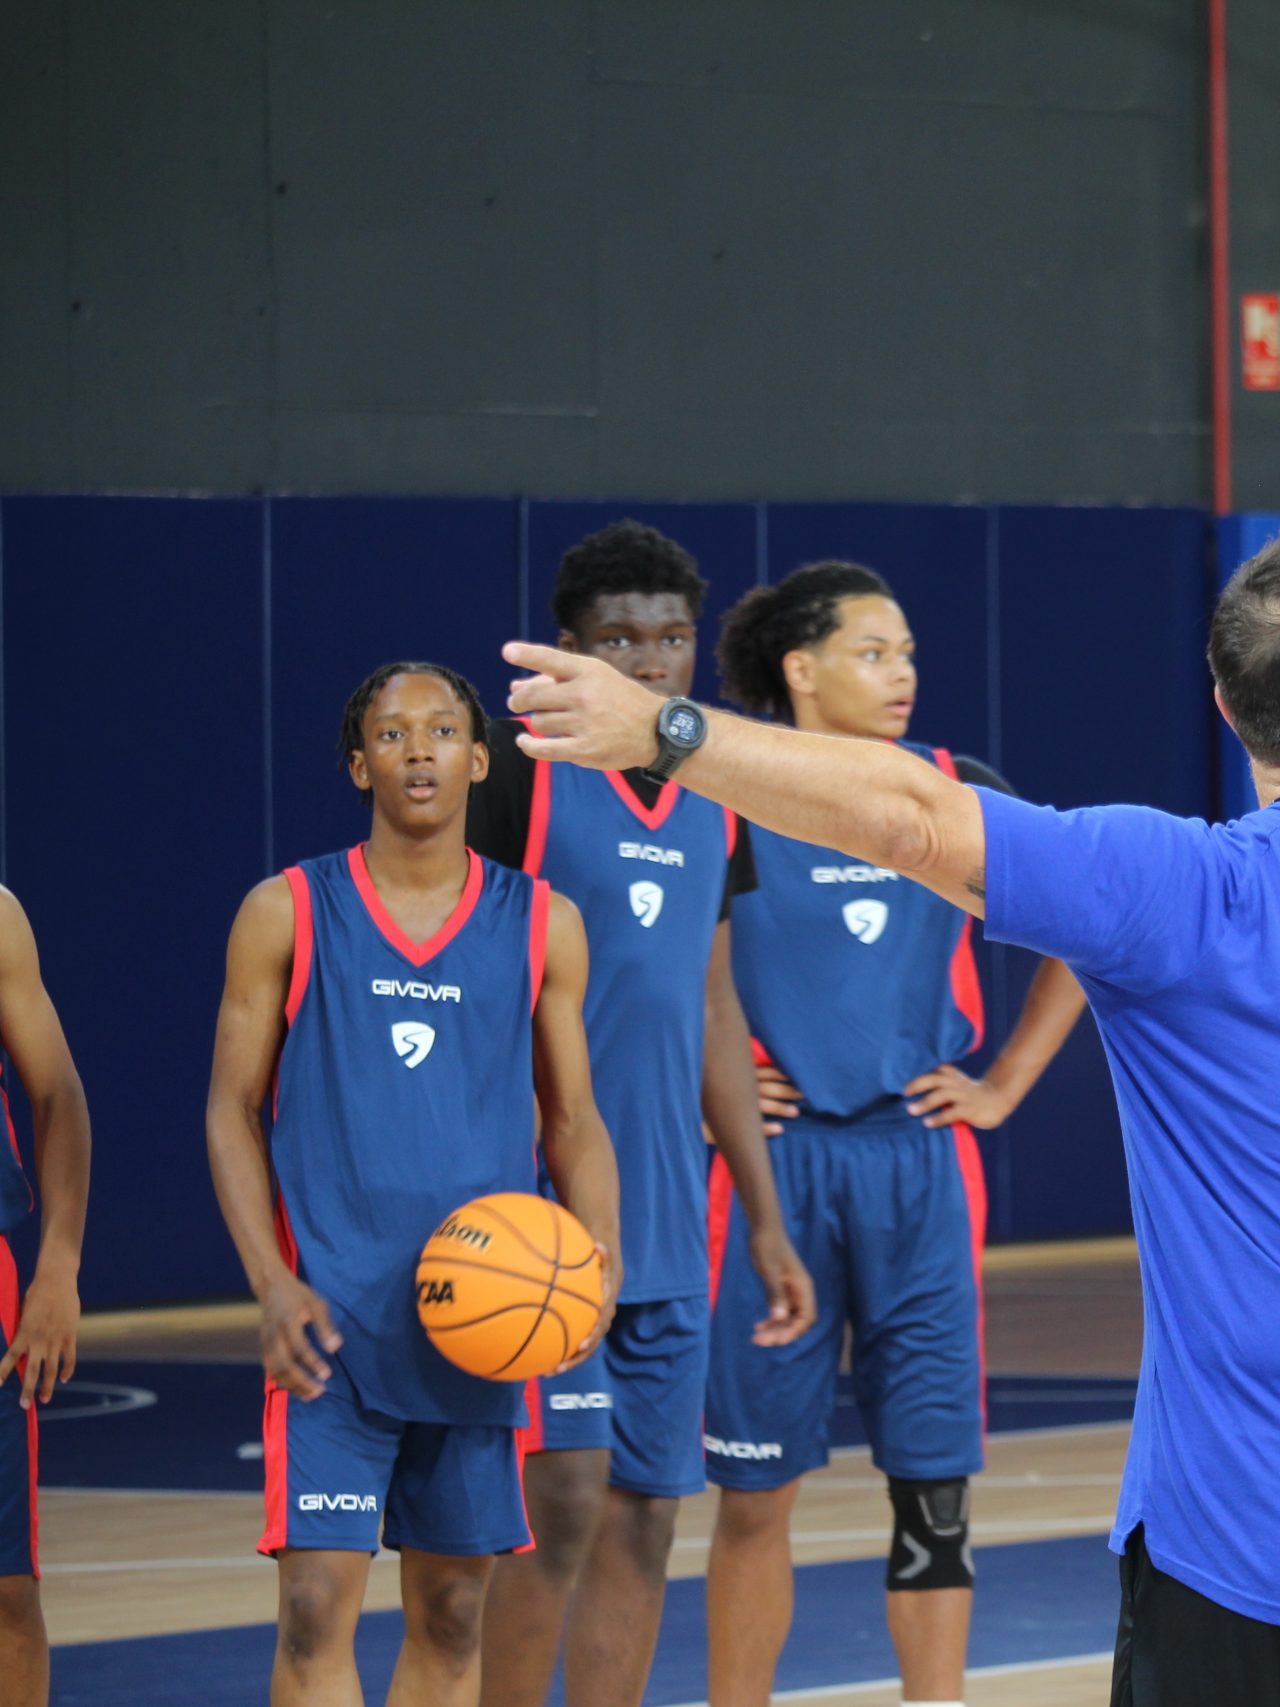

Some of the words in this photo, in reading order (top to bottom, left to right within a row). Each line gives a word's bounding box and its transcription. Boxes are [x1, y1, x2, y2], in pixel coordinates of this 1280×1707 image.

[372, 979, 461, 1003] GIVOVA
[417, 1281, 454, 1304] CAA
[299, 1493, 378, 1512] GIVOVA
